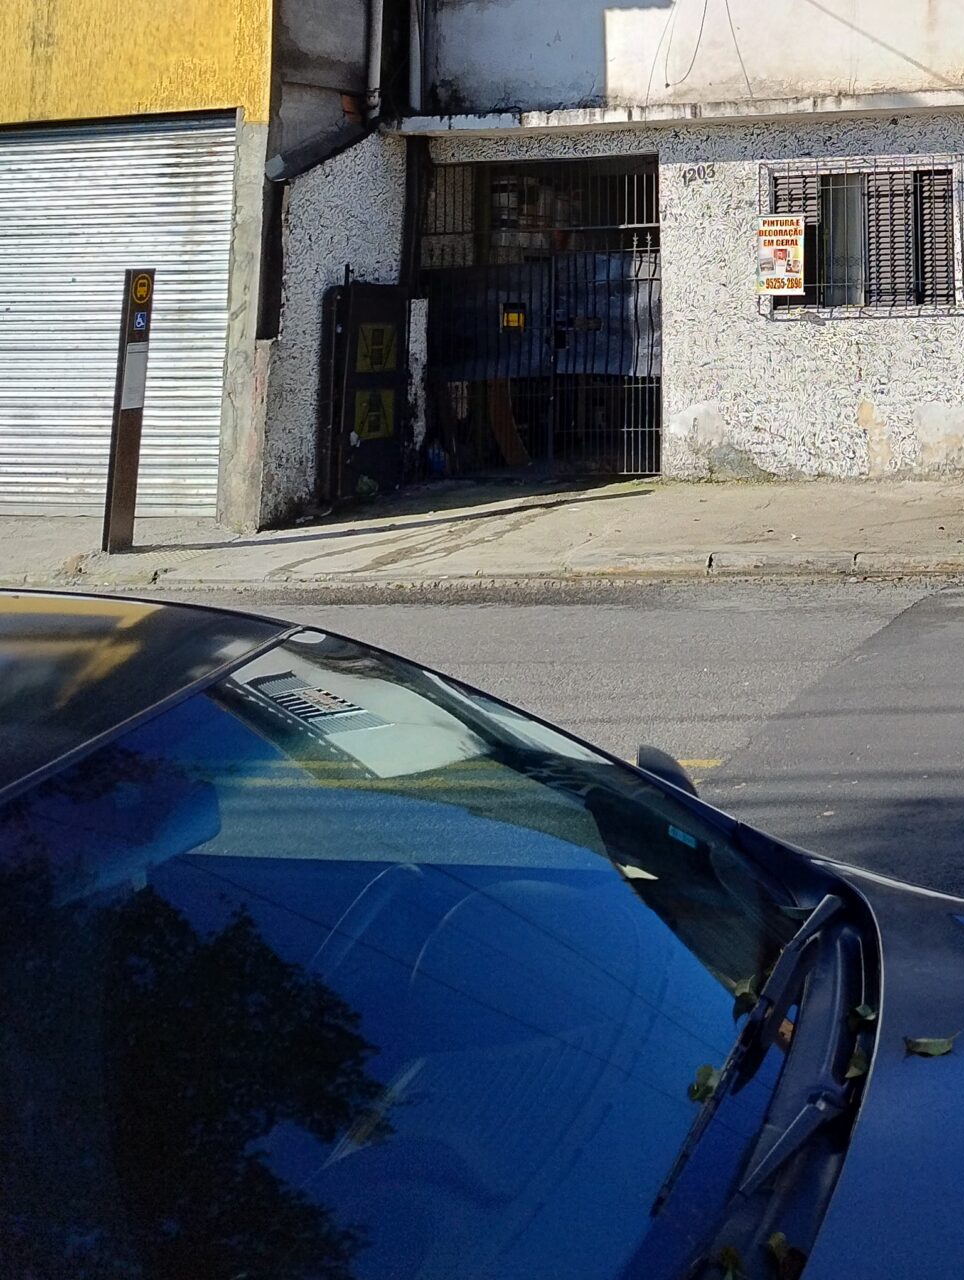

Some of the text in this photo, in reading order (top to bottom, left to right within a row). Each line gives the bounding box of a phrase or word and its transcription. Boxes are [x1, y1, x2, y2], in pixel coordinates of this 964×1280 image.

[682, 164, 716, 186] 1203
[762, 219, 800, 227] PINTURA E
[758, 227, 803, 237] DECORAÇÃO
[763, 239, 799, 247] EM GERAL
